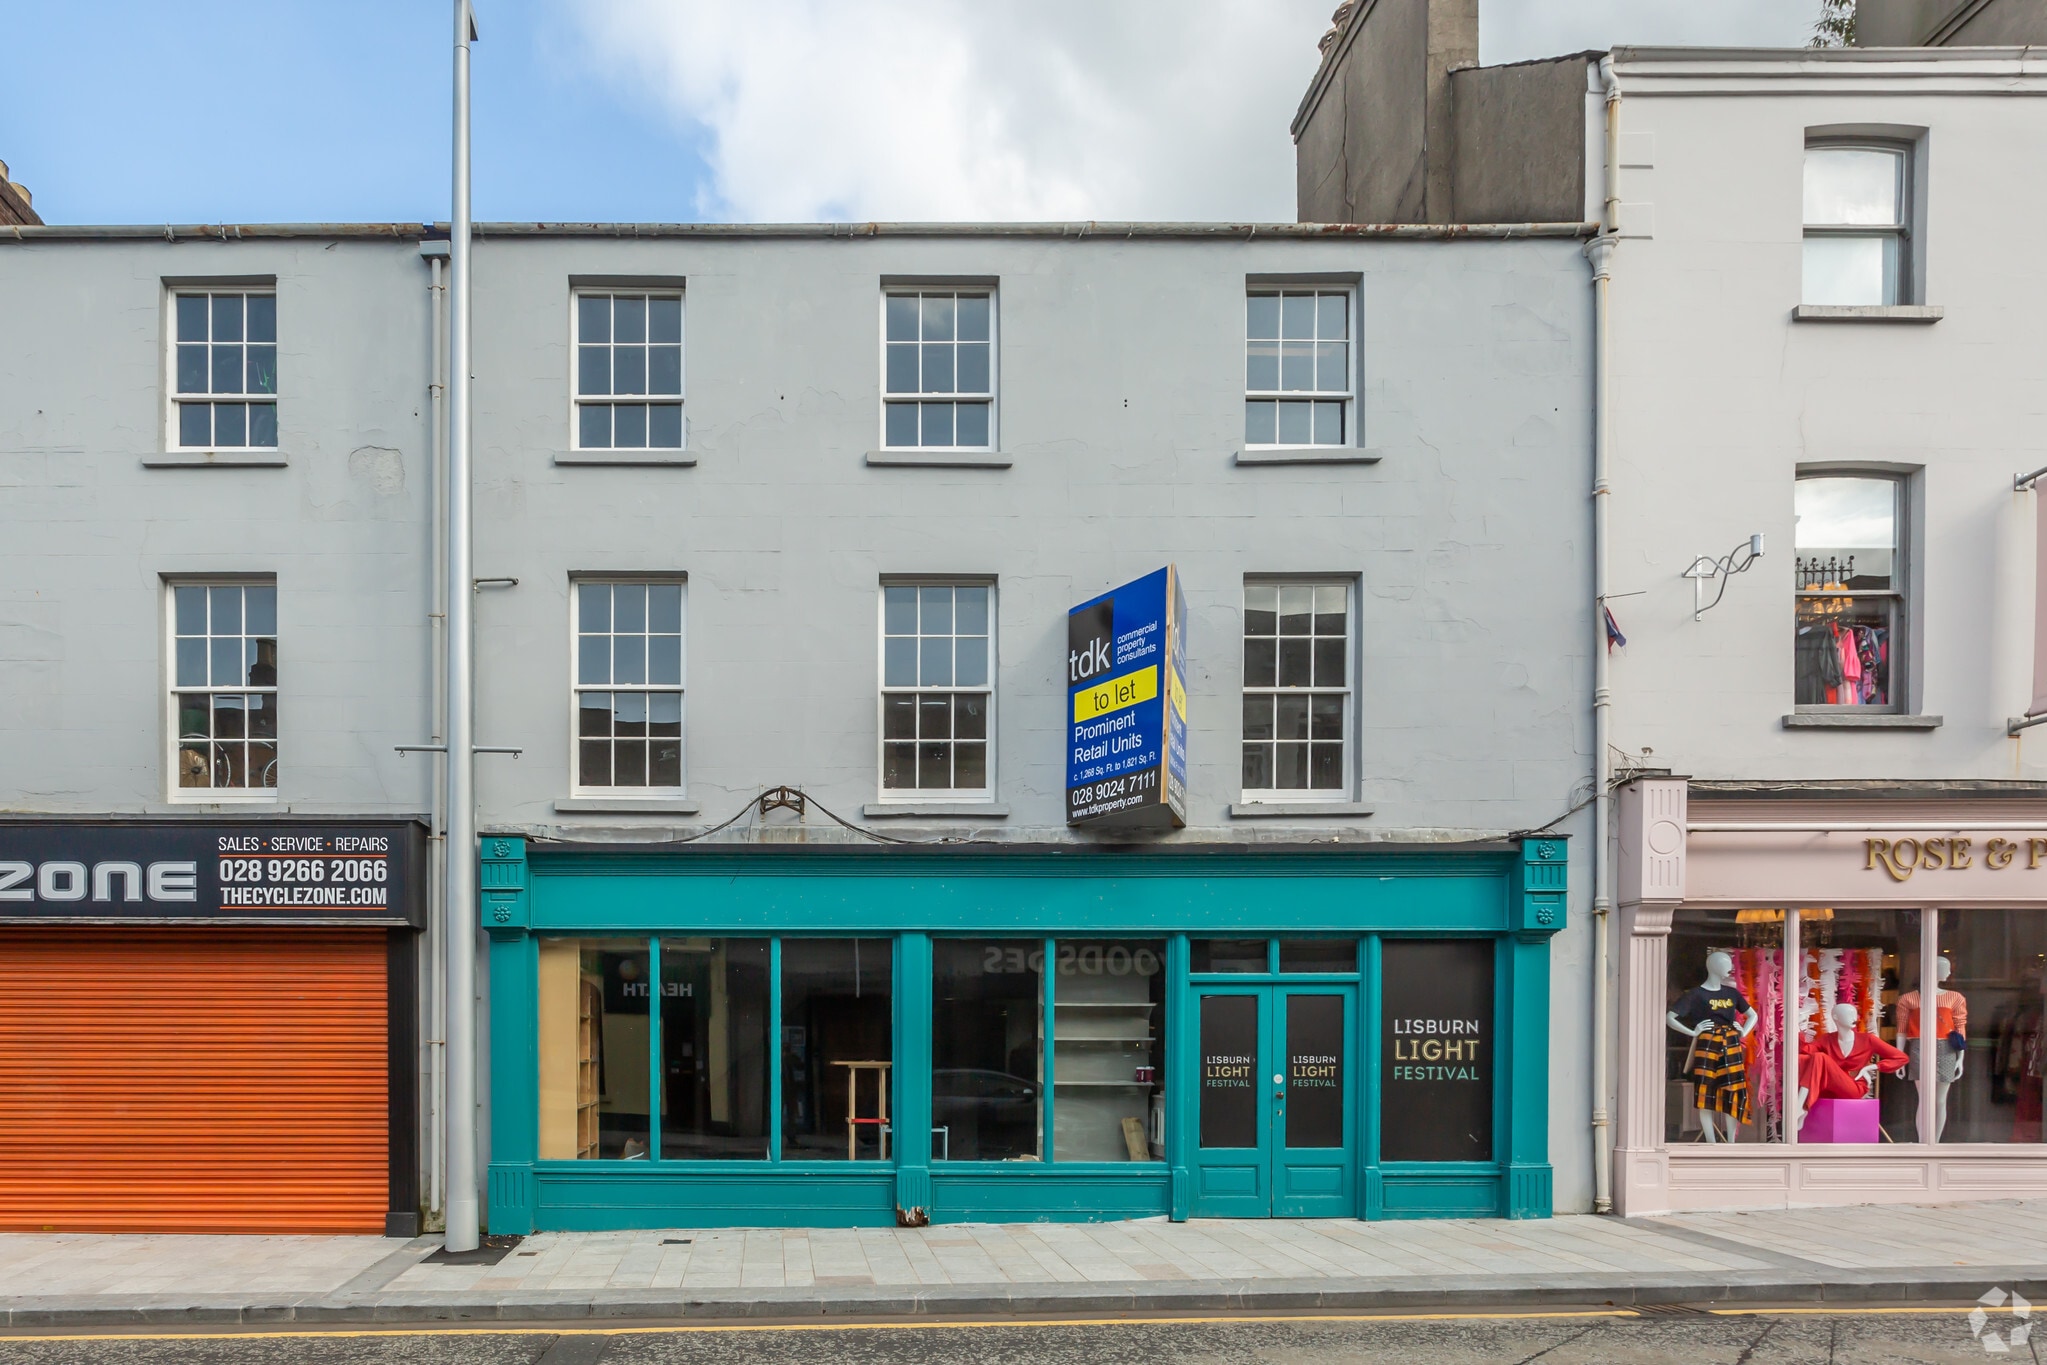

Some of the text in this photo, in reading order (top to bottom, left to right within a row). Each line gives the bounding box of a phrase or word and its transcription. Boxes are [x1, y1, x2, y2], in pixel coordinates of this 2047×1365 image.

[1117, 620, 1158, 644] commercial
[1117, 637, 1146, 656] property
[1117, 644, 1156, 664] consultants
[1069, 637, 1111, 681] tdk
[1094, 679, 1135, 711] to let
[1075, 710, 1135, 743] Prominent
[1074, 733, 1142, 764] Retail Units
[1080, 767, 1095, 780] 1,268
[1115, 762, 1121, 770] to
[1122, 756, 1137, 769] 1,821
[1072, 786, 1093, 806] 028
[1096, 779, 1125, 800] 9024
[1129, 770, 1155, 792] 7111
[1072, 795, 1143, 818] www.tdkproperty.com
[218, 837, 388, 851] SALES SERVICE REPAIRS
[1865, 837, 1973, 881] ROSE
[1986, 837, 2017, 869] &
[219, 859, 387, 882] 028 9266 2066
[220, 887, 387, 905] THECYCLEZONE.COM
[1394, 1019, 1479, 1034] LISBURN
[1206, 1055, 1250, 1064] LISBURN
[1293, 1055, 1336, 1064] LISBURN
[1395, 1039, 1480, 1061] LIGHT
[1207, 1066, 1250, 1077] LIGHT
[1293, 1066, 1337, 1077] LIGHT
[1394, 1066, 1480, 1080] FESTIVAL
[1206, 1079, 1250, 1087] FESTIVAL
[1293, 1079, 1337, 1087] FESTIVAL
